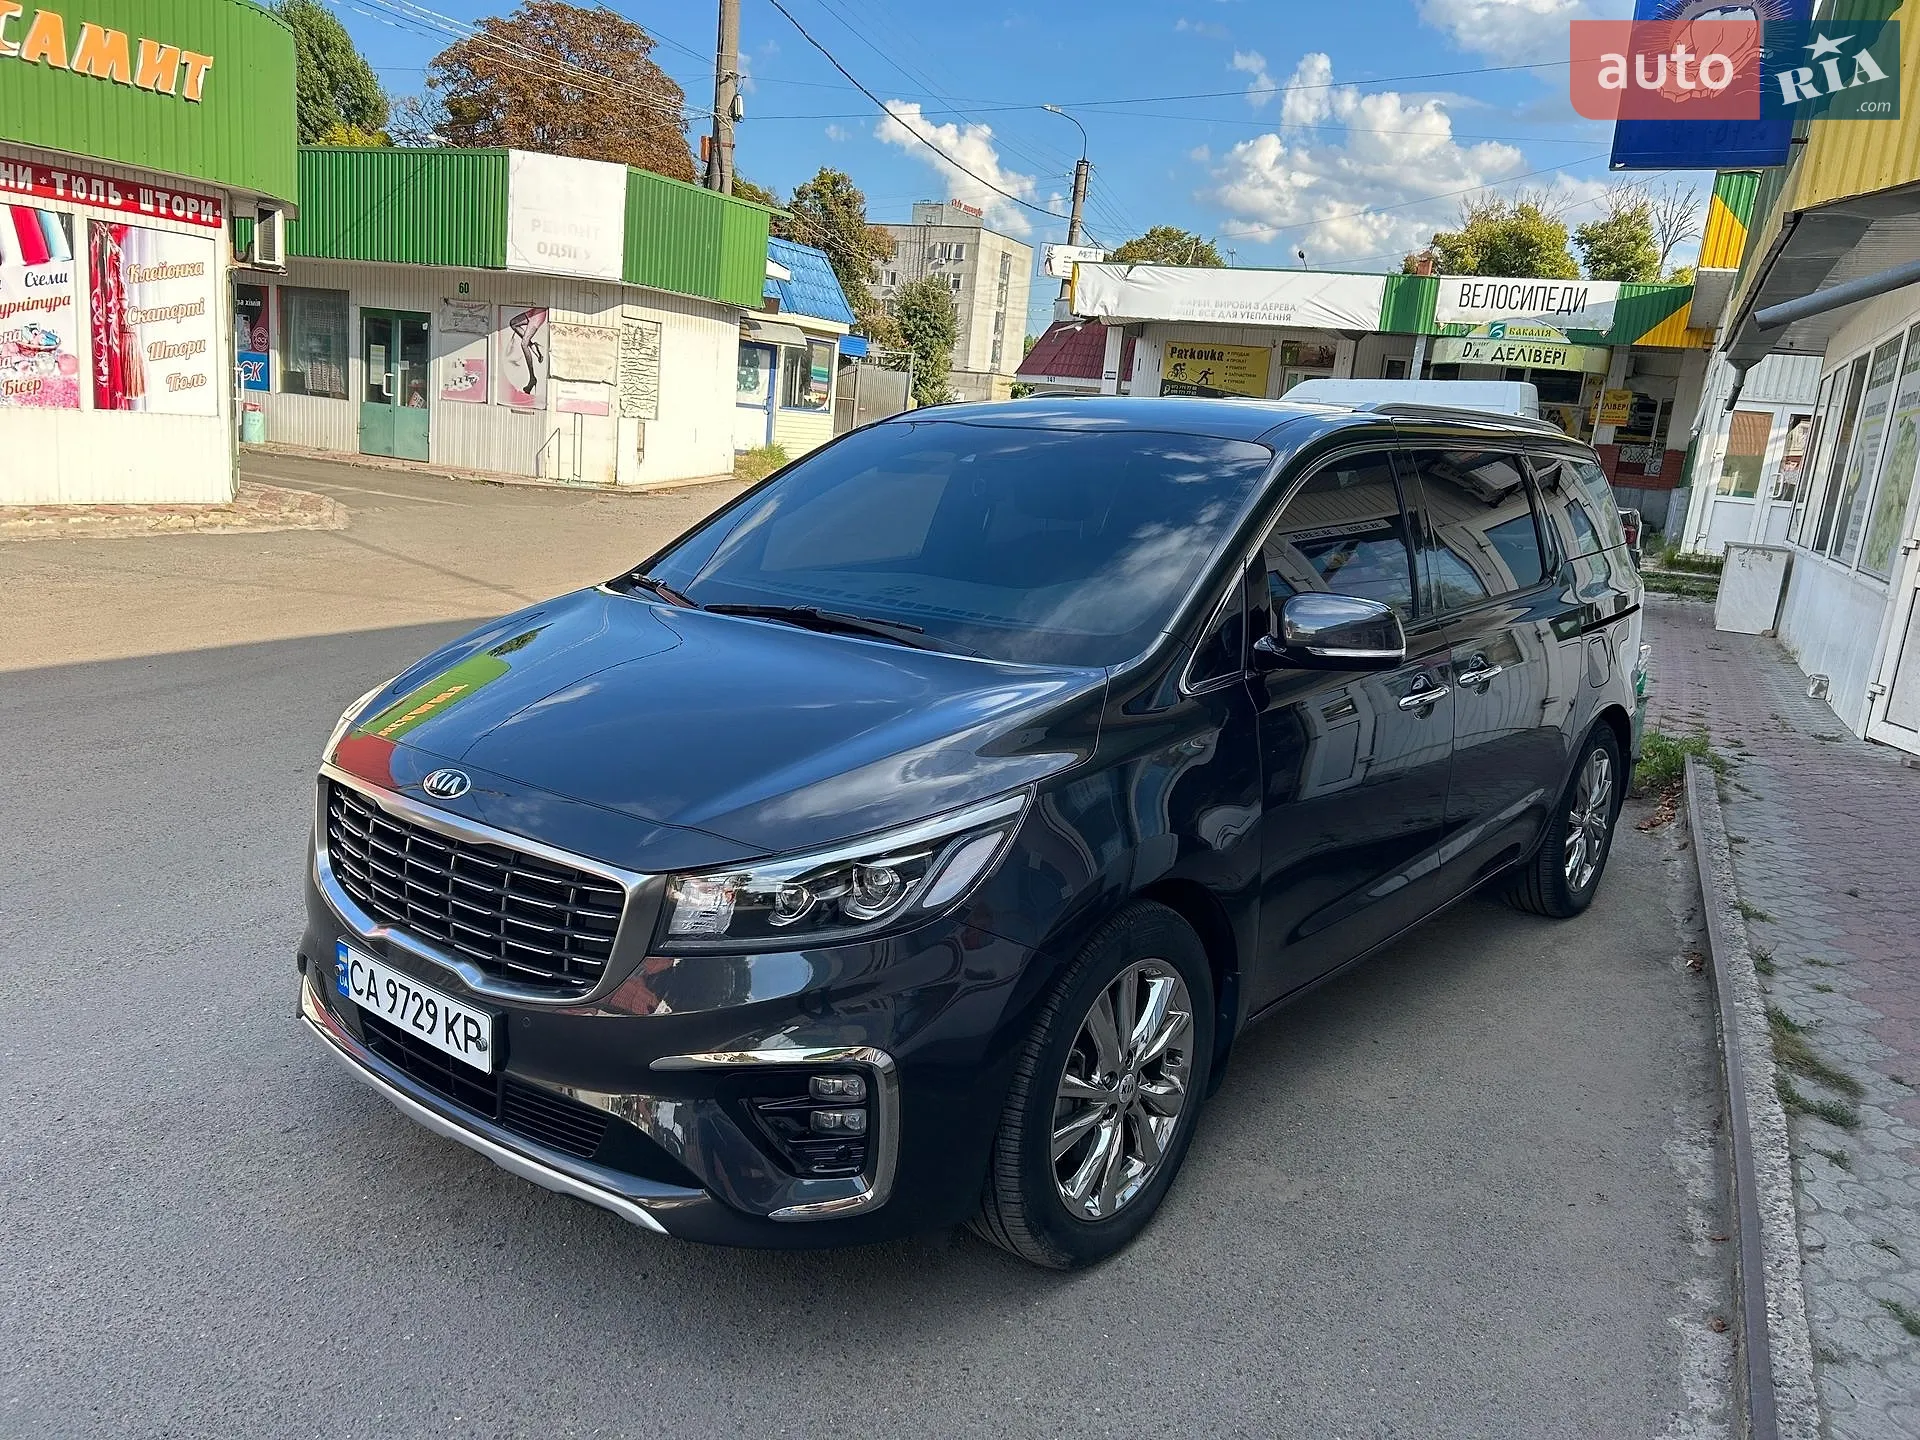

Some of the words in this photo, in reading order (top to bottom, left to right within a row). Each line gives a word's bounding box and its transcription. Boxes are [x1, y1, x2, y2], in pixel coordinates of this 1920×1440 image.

[51, 171, 123, 206] ТЮЛЬ
[139, 187, 213, 223] ШТОРИ
[24, 271, 68, 288] Схеми
[127, 261, 204, 284] Клейонка
[459, 282, 469, 293] 60
[0, 295, 71, 319] урнітура
[1459, 283, 1588, 315] ВЕЛОСИПЕДИ
[127, 297, 205, 325] Скатерті
[1217, 310, 1238, 320] ДЛЯ
[1240, 311, 1292, 322] УТЕПЛЕННЯ
[147, 339, 206, 361] Штори
[1170, 346, 1224, 361] Parkovka
[1491, 347, 1567, 366] ДЕЛІВЕРІ
[3, 379, 42, 396] Бісер
[166, 372, 207, 392] Тюль
[427, 772, 462, 794] KIA
[350, 959, 380, 1008] CA
[385, 978, 438, 1035] 9729
[444, 1006, 482, 1054] KP
